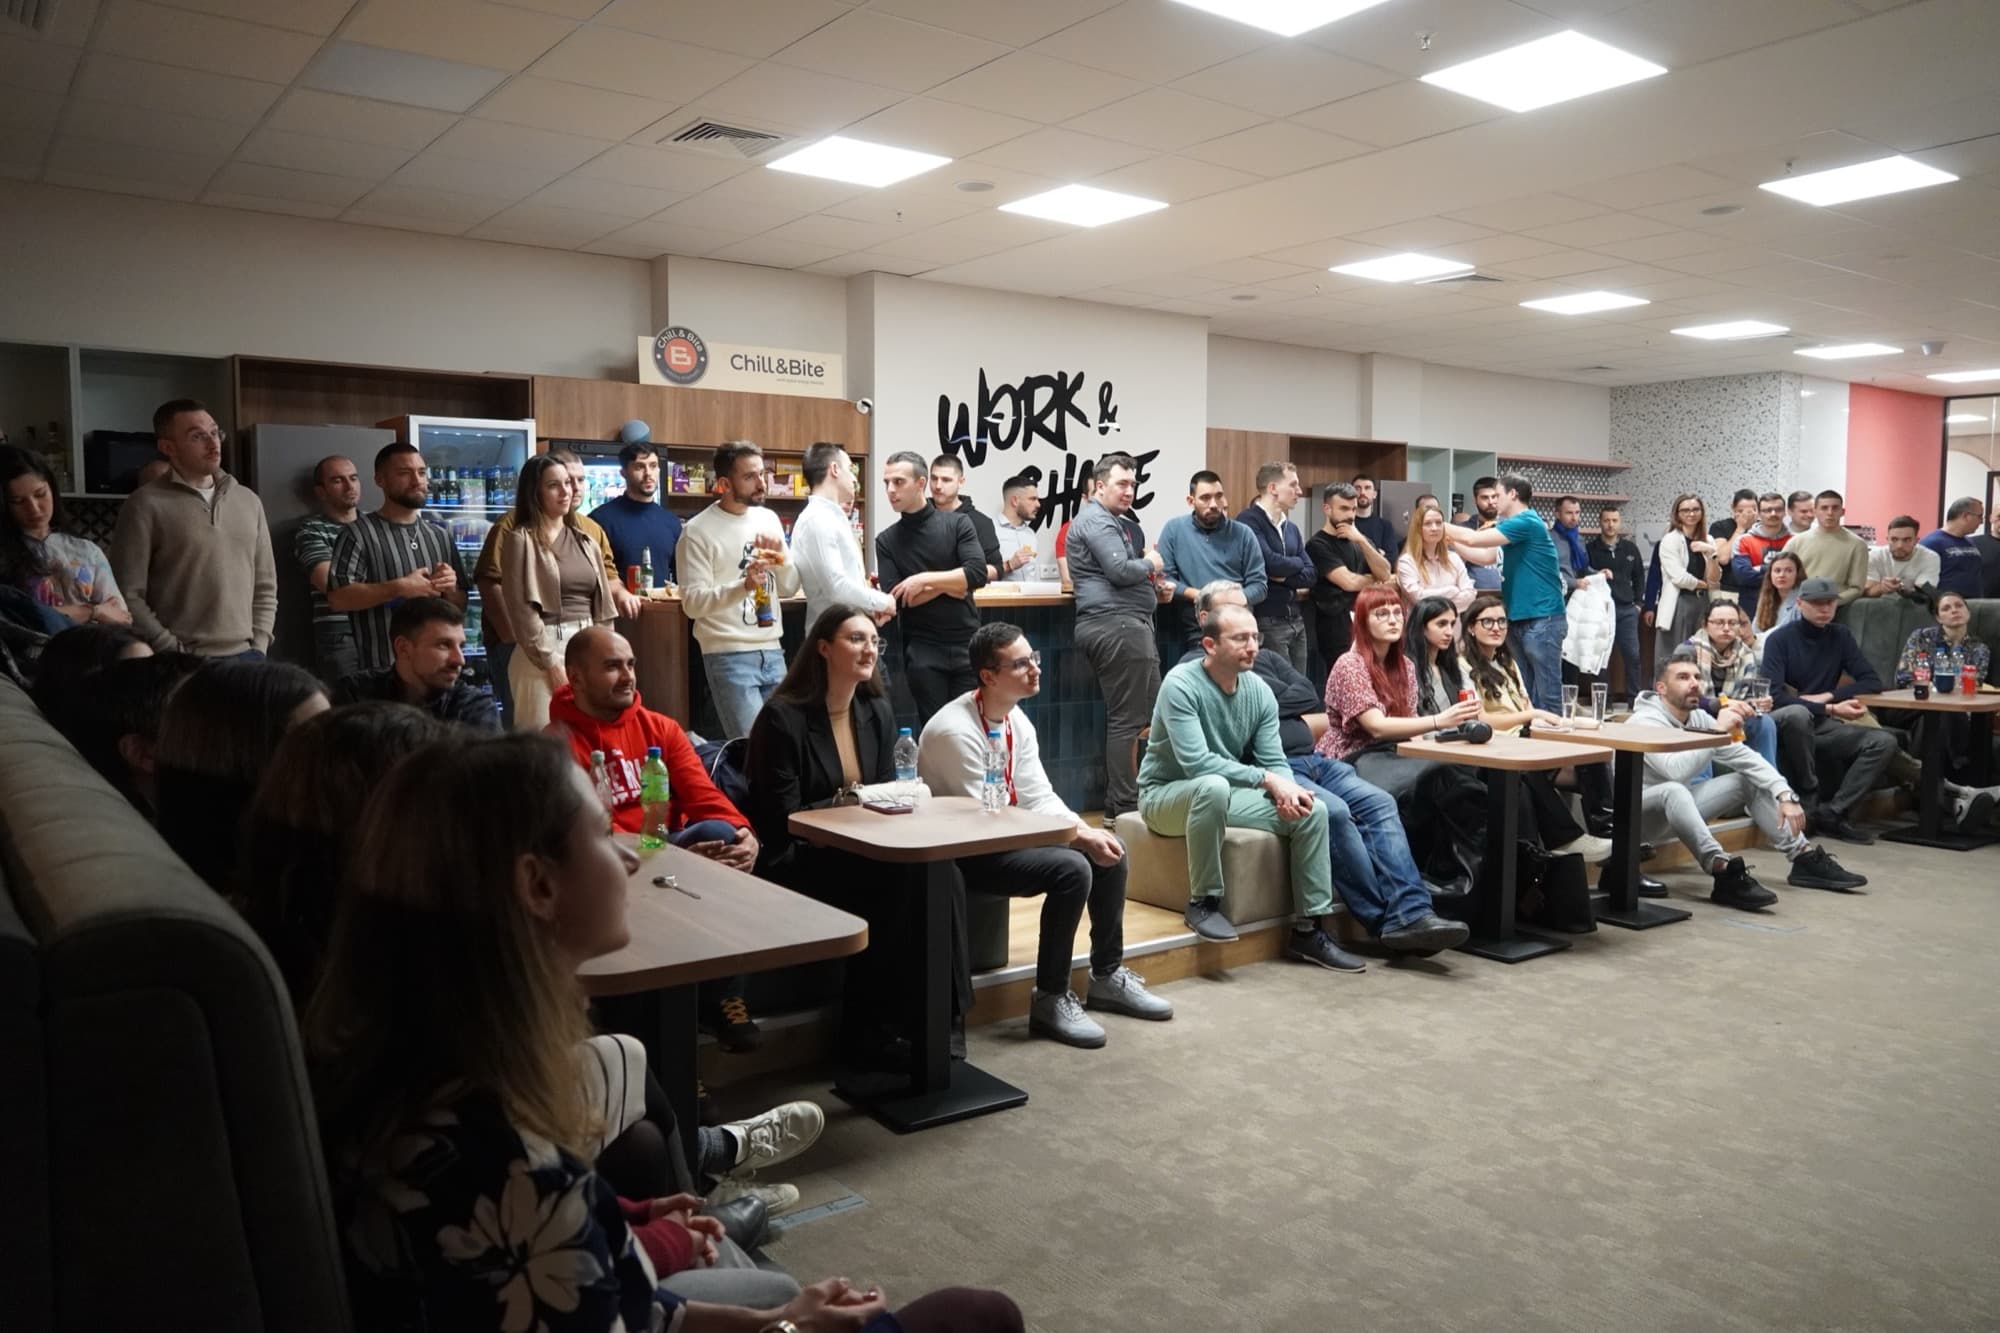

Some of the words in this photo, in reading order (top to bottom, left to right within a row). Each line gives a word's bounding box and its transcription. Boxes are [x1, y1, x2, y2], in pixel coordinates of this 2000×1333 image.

[657, 329, 678, 349] Chill
[678, 329, 685, 338] &
[686, 332, 703, 352] Bite
[730, 353, 825, 378] Chill&Bite
[938, 367, 1091, 468] WORK
[1098, 380, 1121, 435] &
